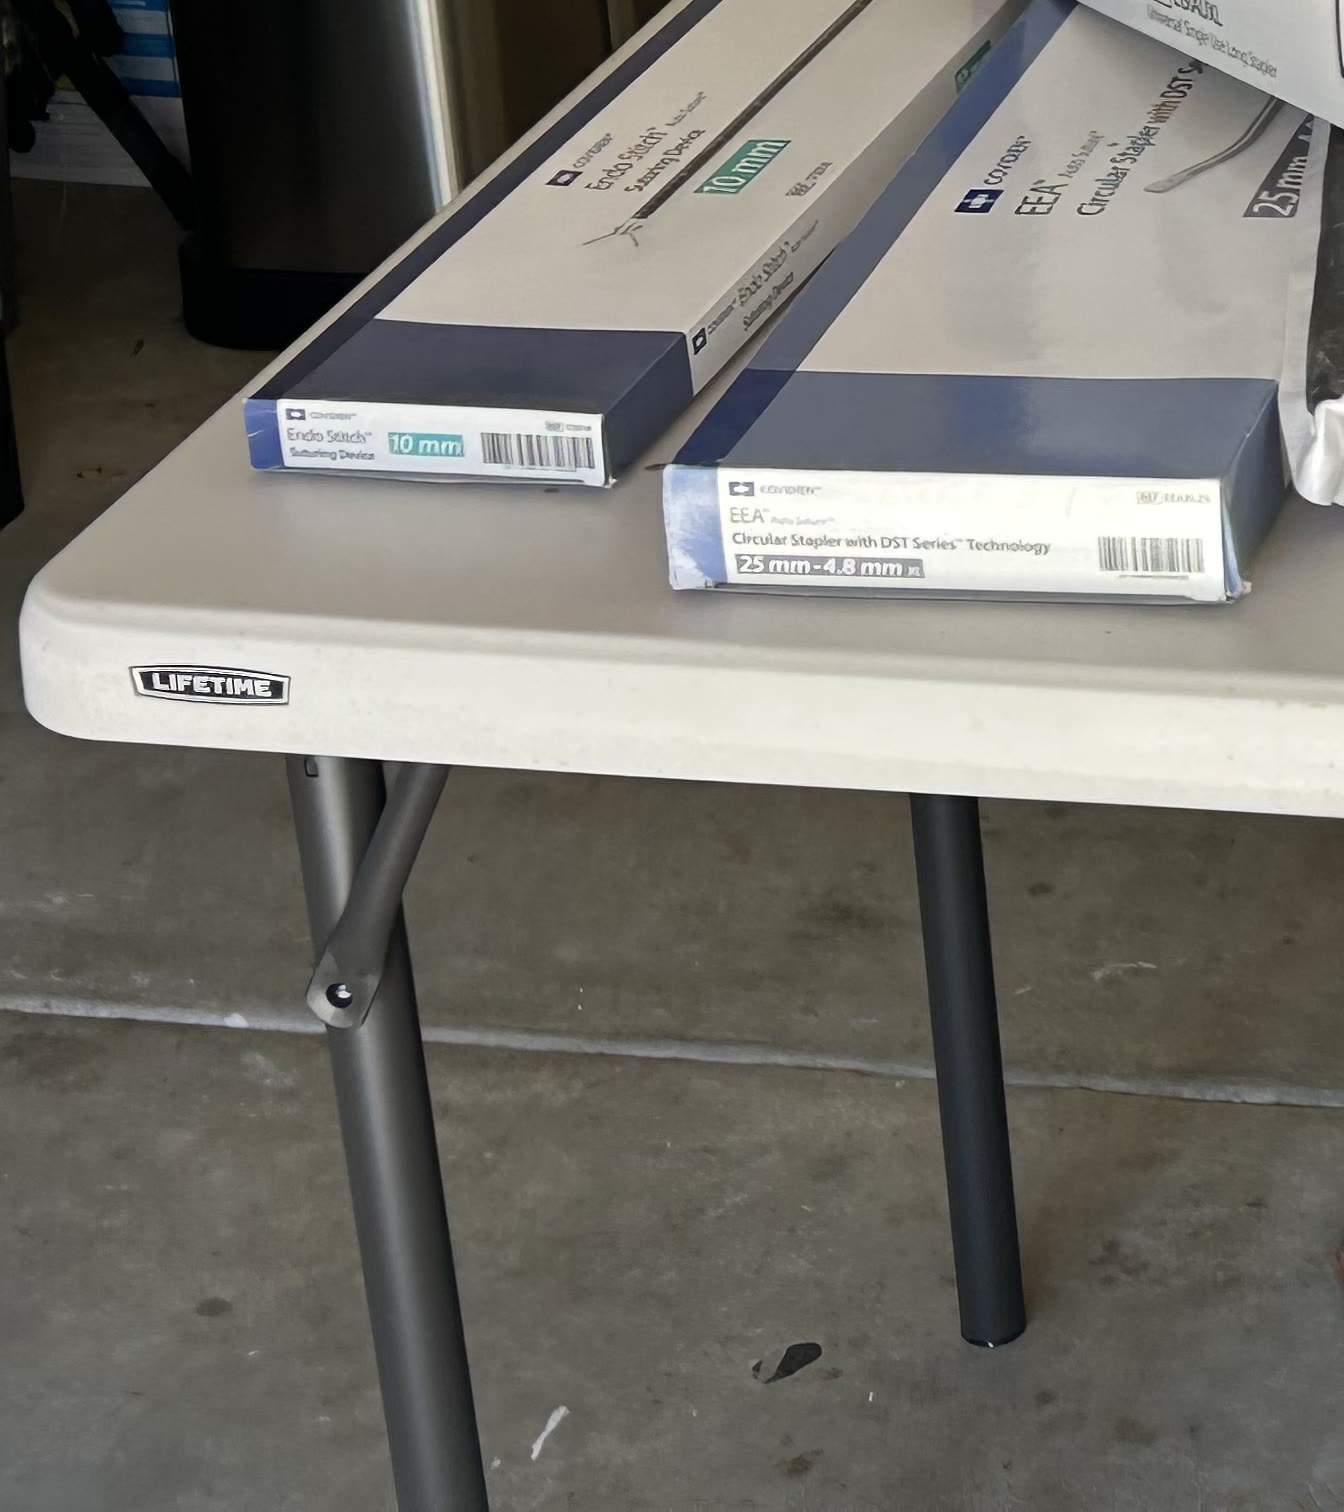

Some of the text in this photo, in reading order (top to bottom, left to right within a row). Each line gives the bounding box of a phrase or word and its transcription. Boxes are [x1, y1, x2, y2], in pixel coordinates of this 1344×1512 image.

[1160, 76, 1195, 112] DST
[1148, 99, 1174, 128] with
[1112, 123, 1160, 166] Stapler
[703, 139, 787, 193] 10 mm
[1077, 162, 1129, 216] Circular
[1252, 189, 1300, 217] 25
[390, 433, 463, 455] 10 mm
[732, 532, 788, 548] Circular
[791, 533, 842, 551] Stapler
[845, 535, 878, 549] with
[881, 537, 910, 550] DST
[966, 539, 1051, 556] Technology
[738, 555, 765, 574] 25
[859, 560, 904, 576] mm
[151, 672, 273, 698] LIFETIME
